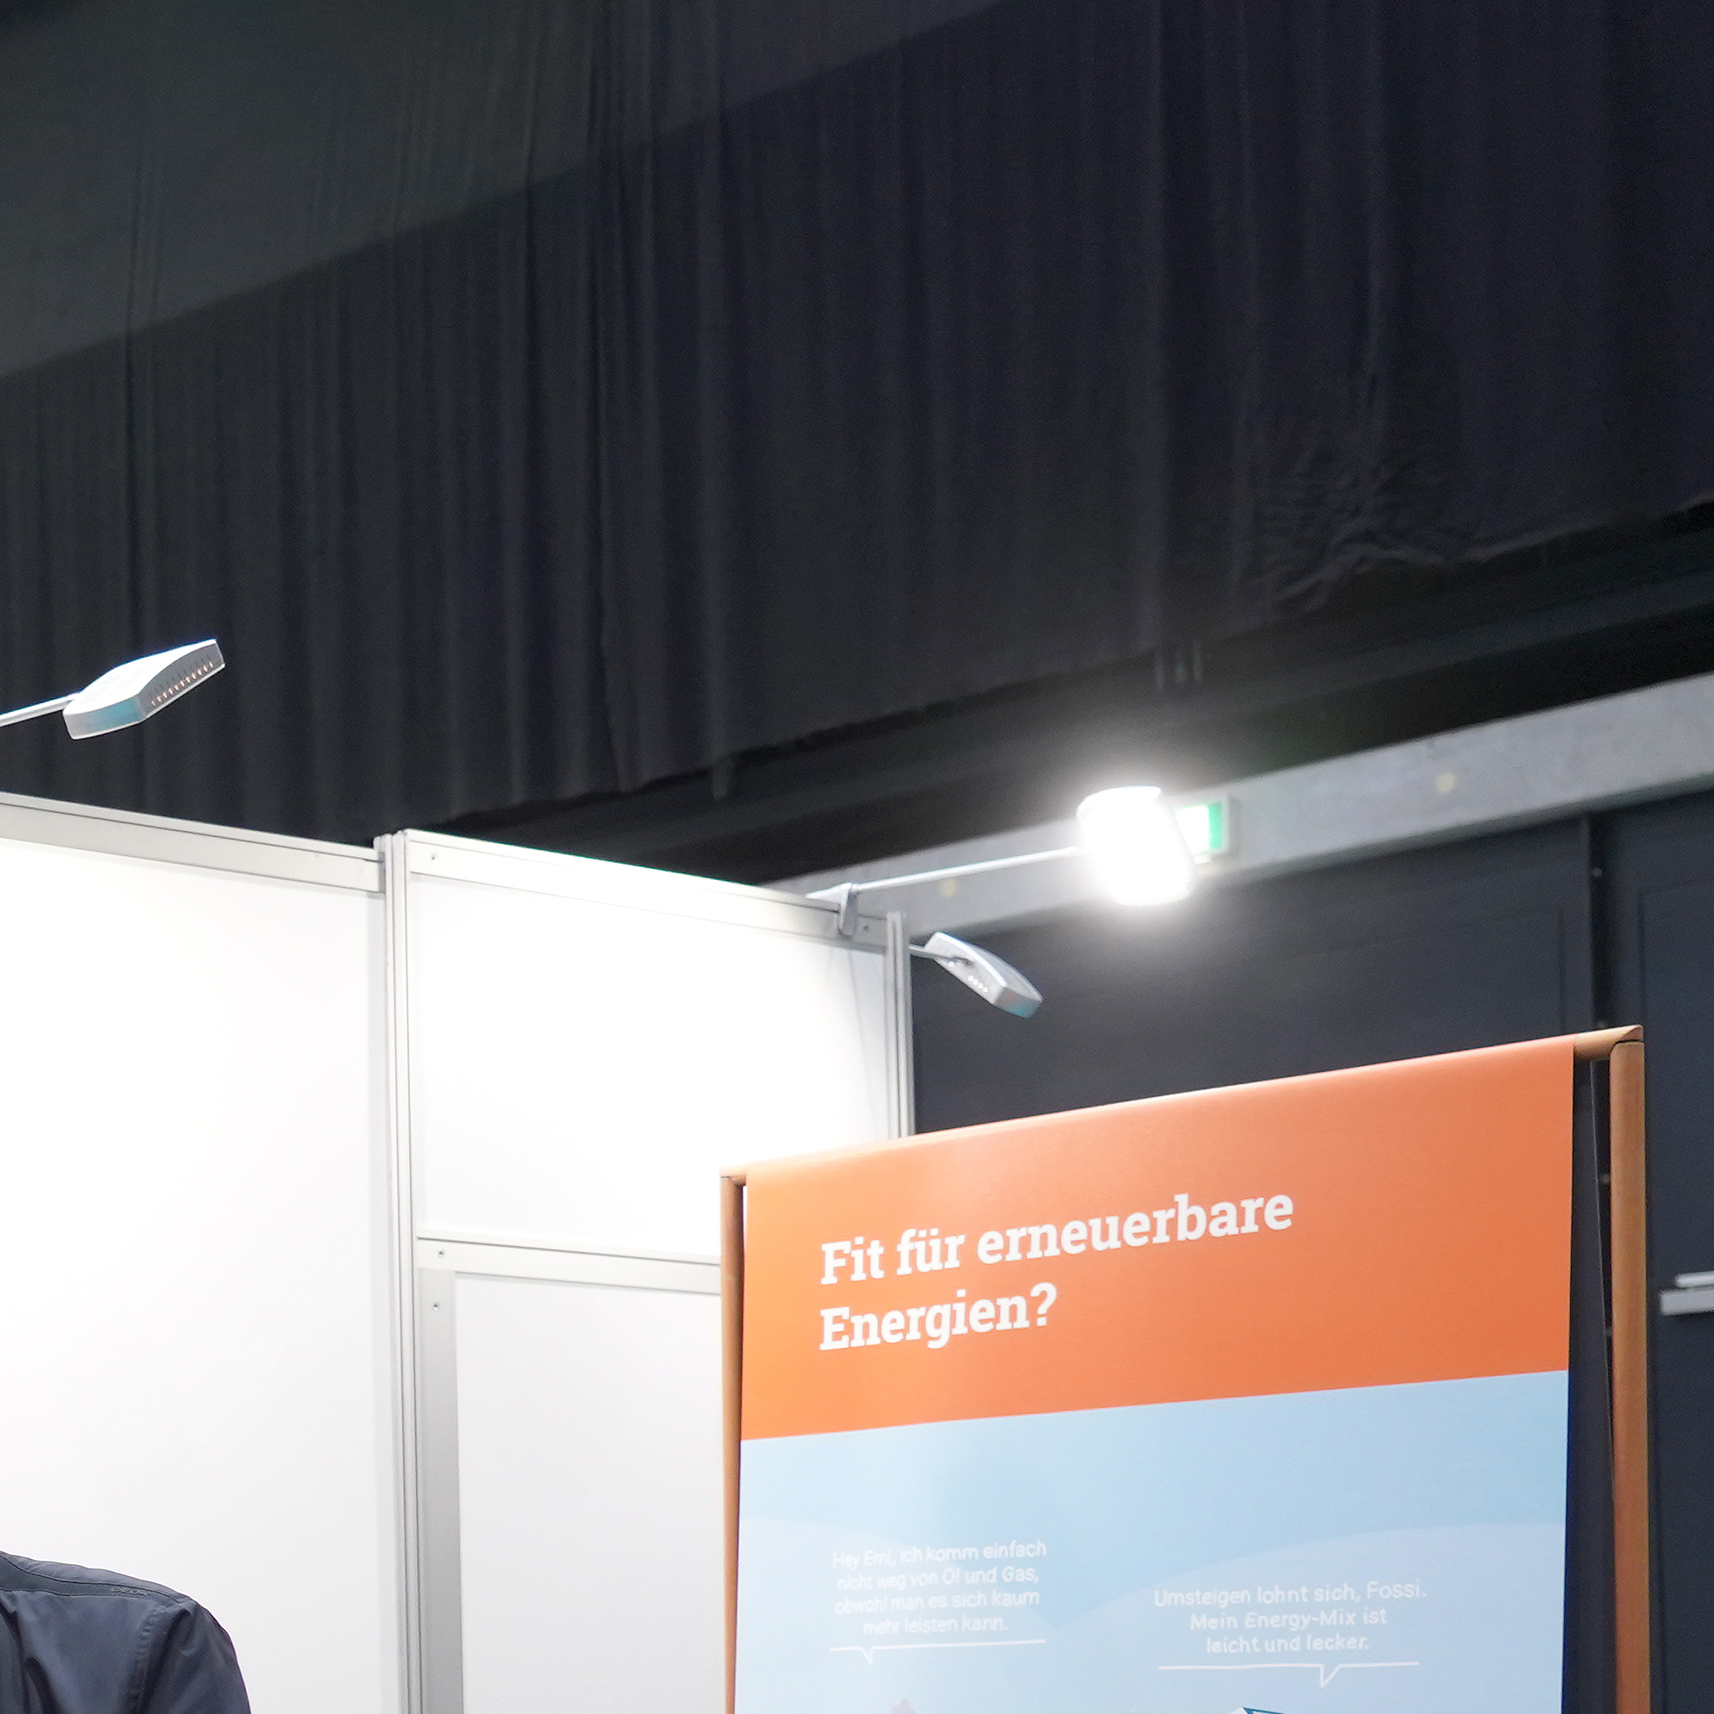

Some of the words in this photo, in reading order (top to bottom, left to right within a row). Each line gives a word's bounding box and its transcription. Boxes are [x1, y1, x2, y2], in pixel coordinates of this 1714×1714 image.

[821, 1237, 884, 1284] Fit
[896, 1229, 965, 1274] für
[977, 1193, 1293, 1263] erneuerbare
[819, 1283, 1057, 1349] Energien?
[1154, 1590, 1251, 1607] Umsteigen
[1257, 1585, 1309, 1604] lohnt
[1190, 1612, 1238, 1630] Mein
[1245, 1609, 1357, 1630] Energy-Mix
[1363, 1607, 1387, 1624] ist
[1206, 1636, 1261, 1653] leicht
[1264, 1635, 1301, 1652] und
